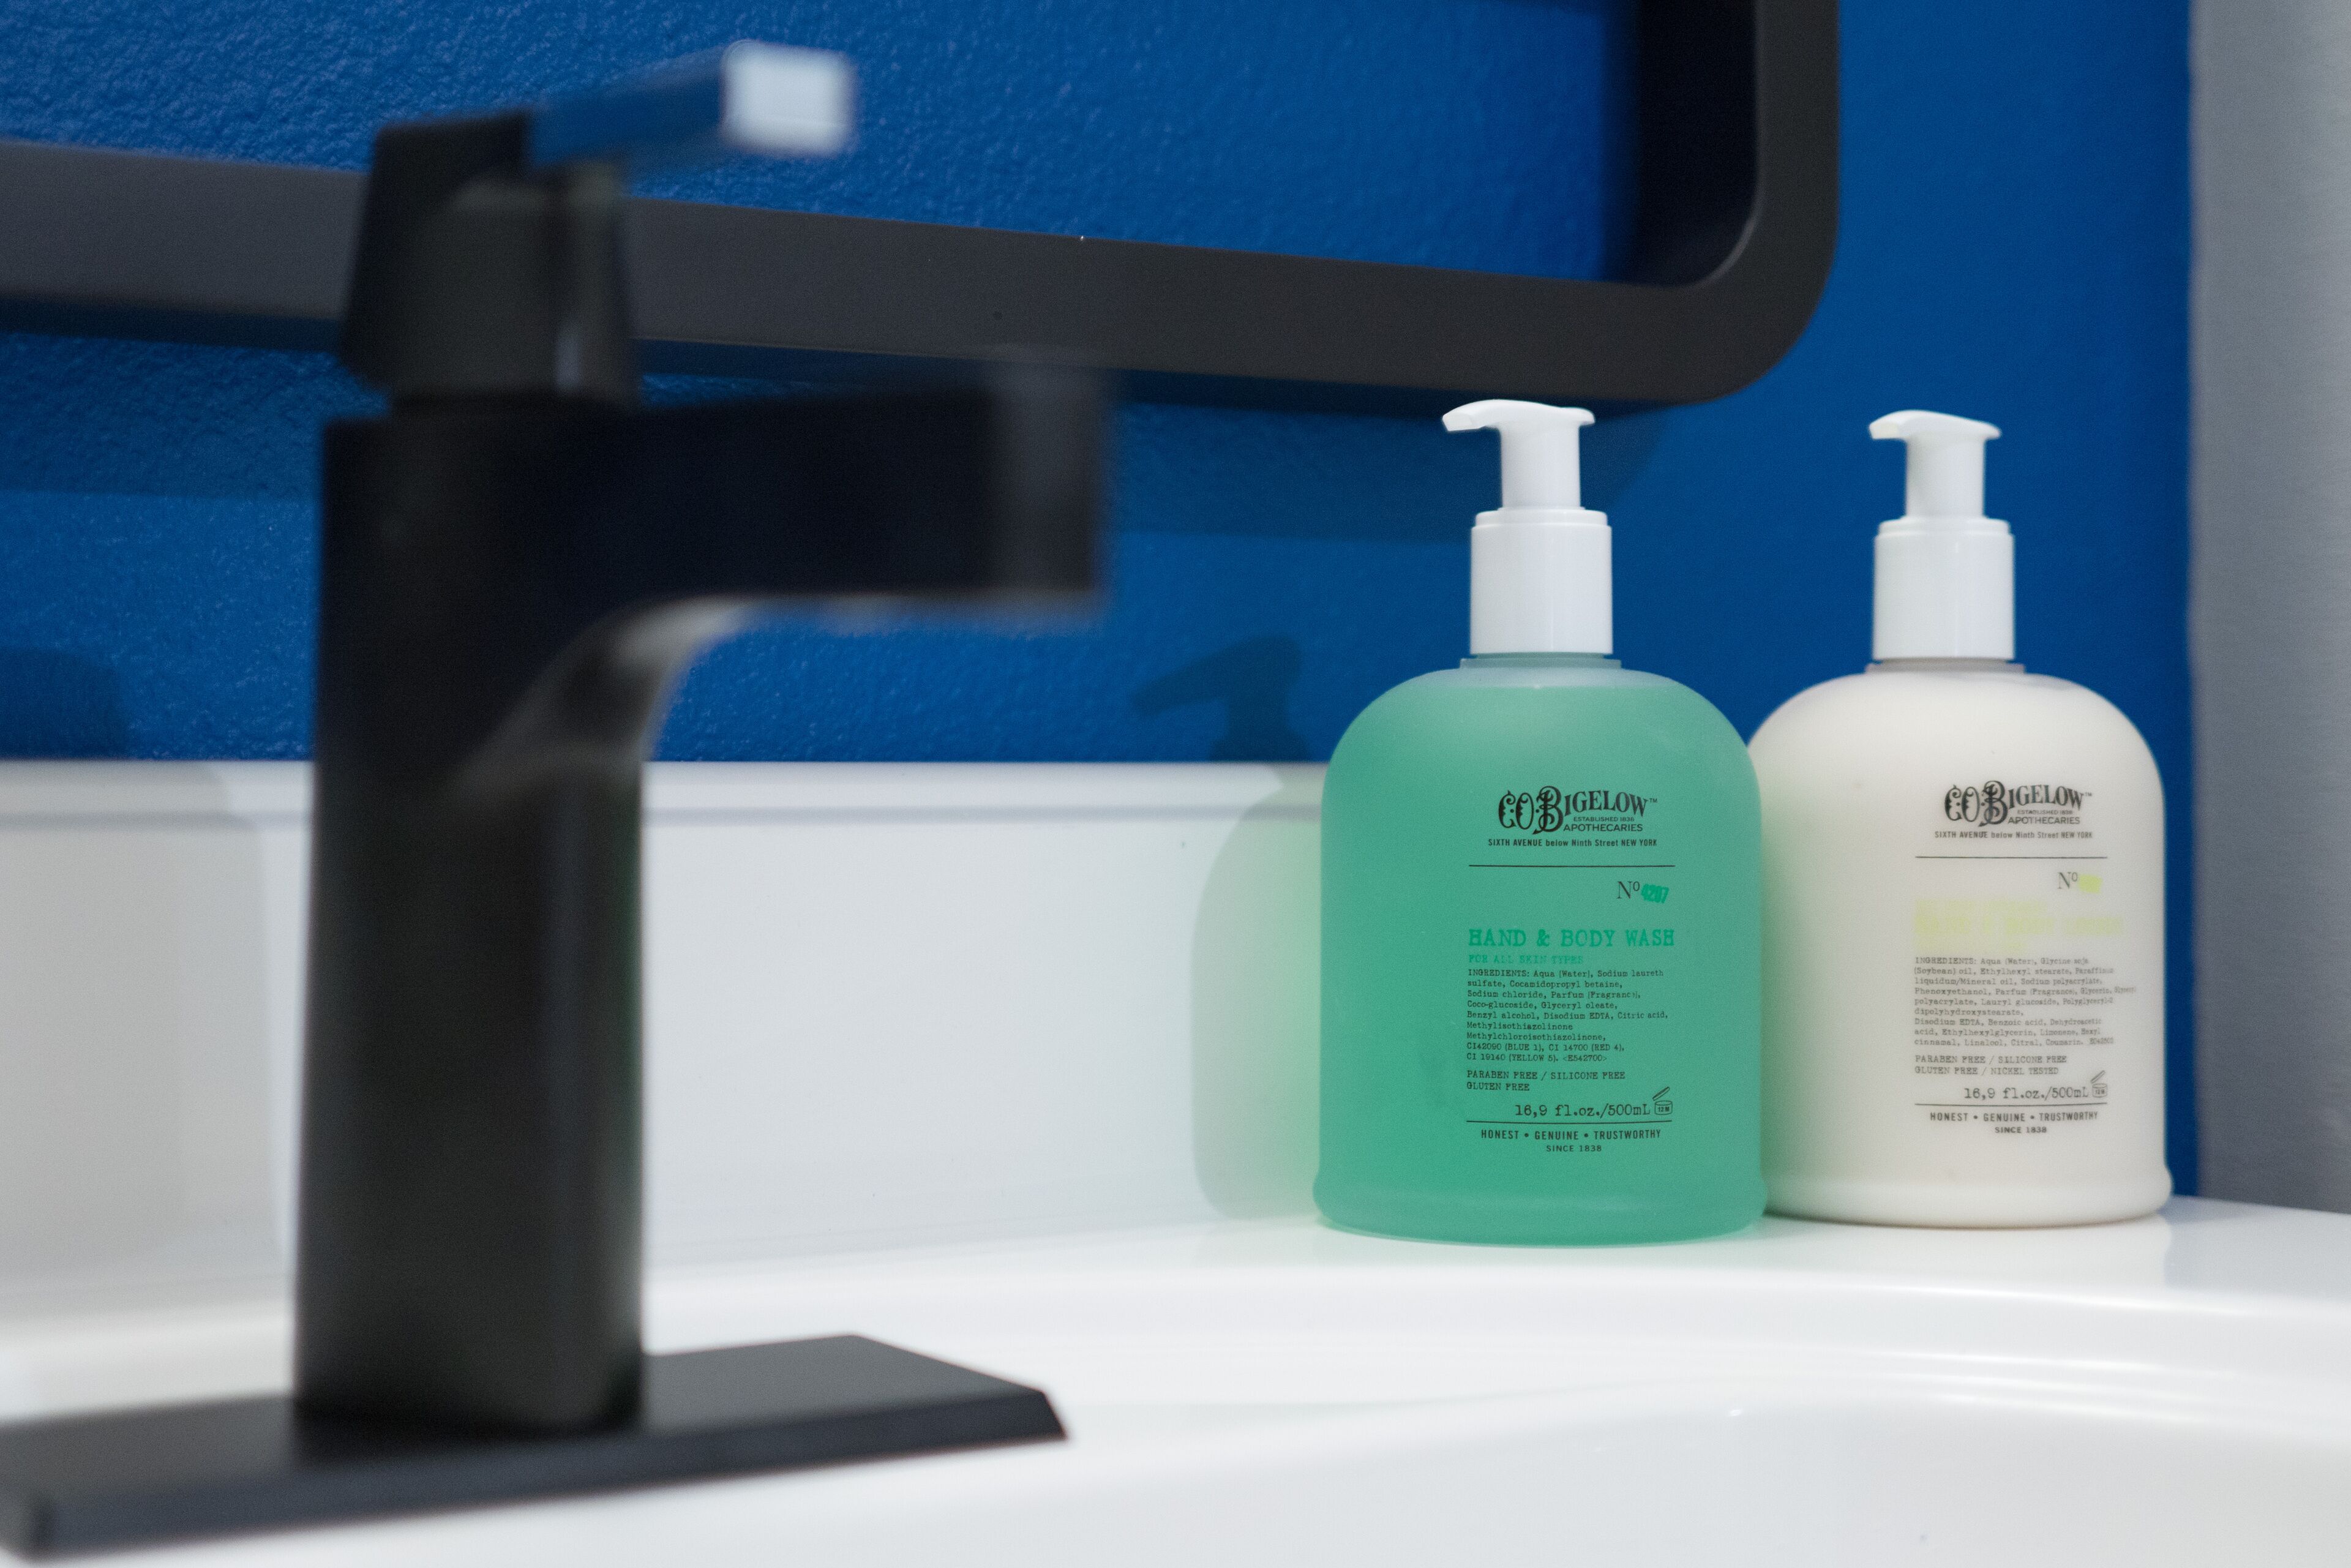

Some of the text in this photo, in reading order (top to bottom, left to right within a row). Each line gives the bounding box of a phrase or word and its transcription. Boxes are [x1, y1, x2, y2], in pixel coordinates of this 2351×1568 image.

[1468, 929, 1674, 947] HAND & BODY WASH
[1469, 955, 1583, 965] FOR ALL SKIN TYPES
[1510, 980, 1580, 989] Cocamidopropyl
[1502, 991, 1547, 999] chloride,
[1468, 1000, 1537, 1010] Coco-glucoside,
[1541, 1002, 1581, 1010] Glyceryl
[1467, 1011, 1496, 1019] Benzyl
[1502, 1011, 1539, 1020] alcohol,
[1467, 1021, 1573, 1030] Methylisothiazolinone
[1467, 1070, 1509, 1079] PARABEN
[1914, 1066, 1949, 1075] GLUTEN
[1467, 1081, 1501, 1090] GLUTEN
[1515, 1105, 1547, 1118] 16,9
[1930, 1111, 2098, 1122] HONEST GENUINE TRUSTWORTHY
[1481, 1130, 1660, 1140] HONEST GENUINE TRUSTWORTHY
